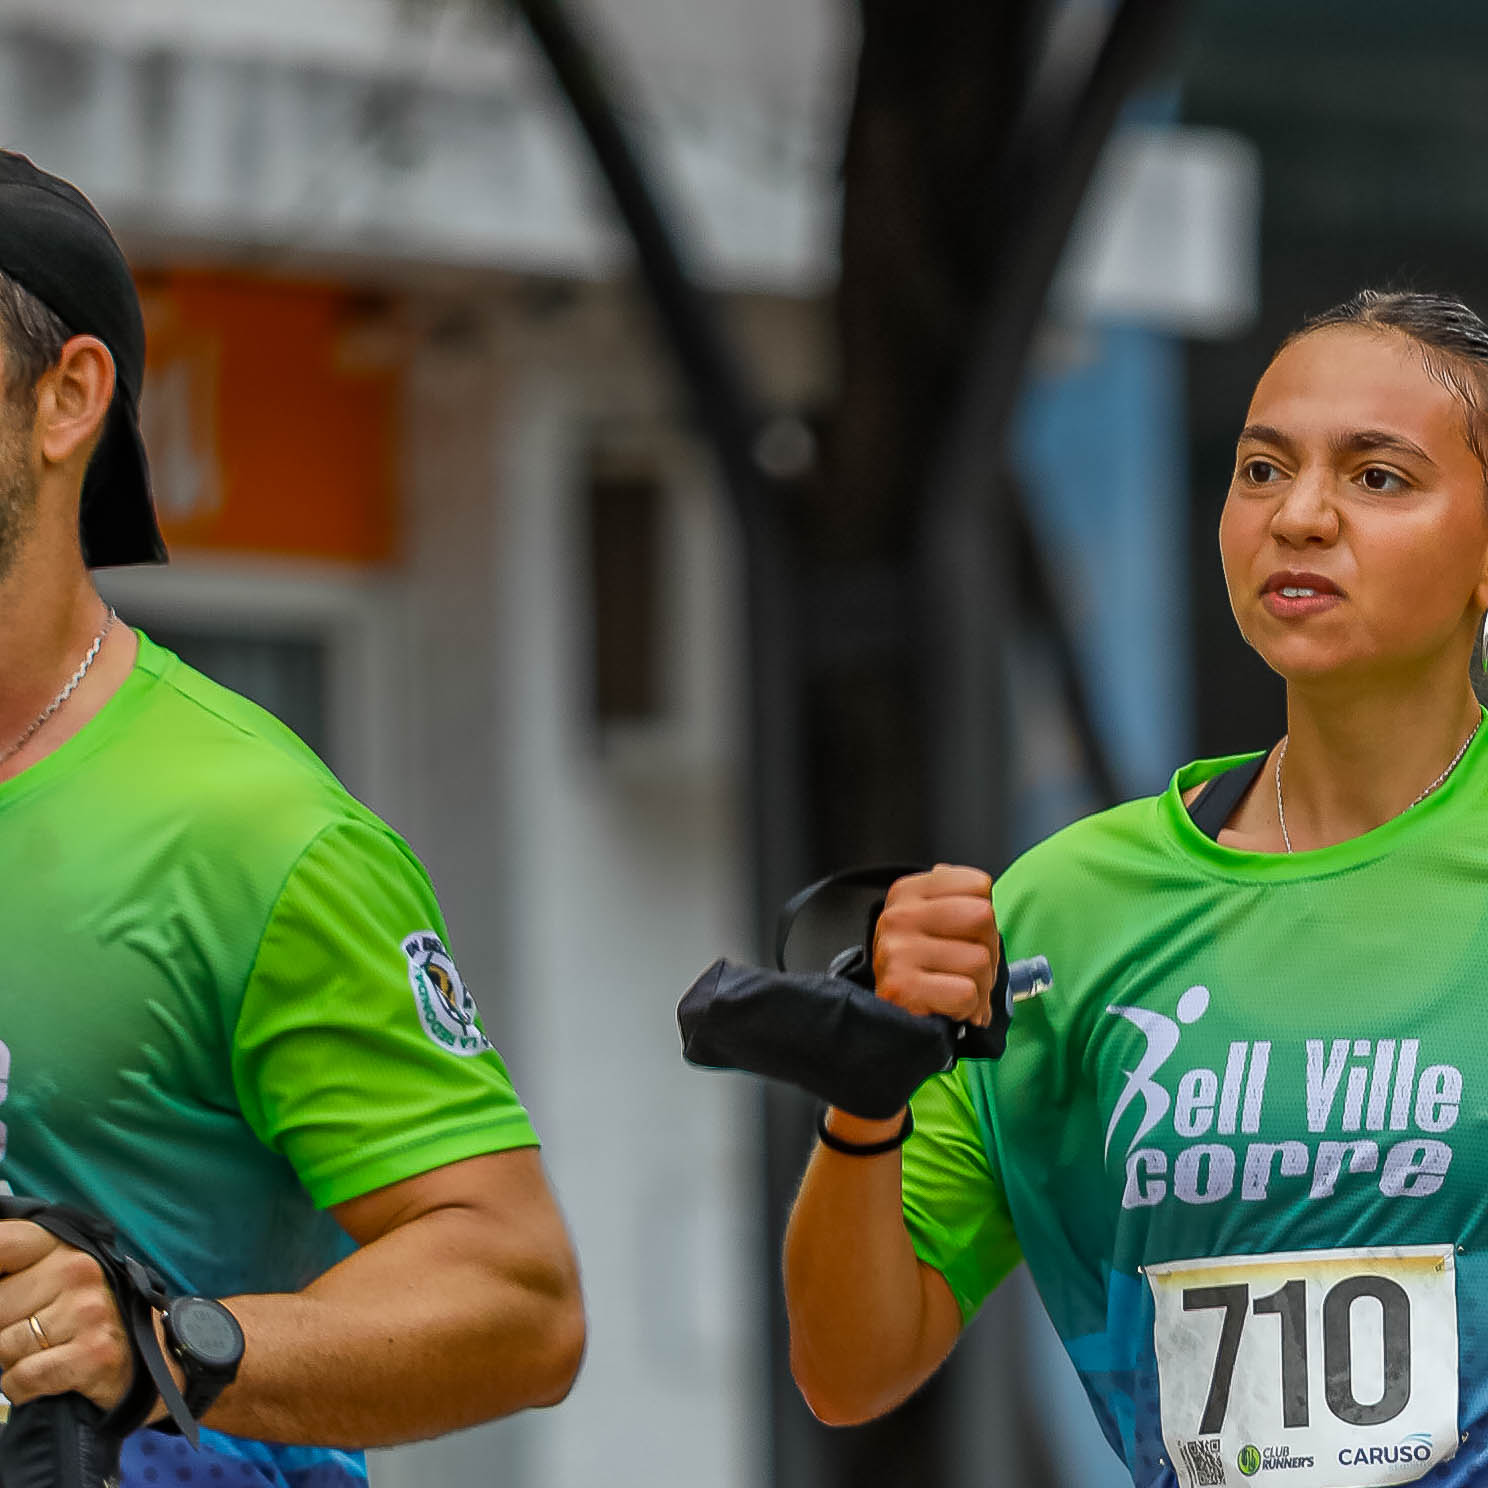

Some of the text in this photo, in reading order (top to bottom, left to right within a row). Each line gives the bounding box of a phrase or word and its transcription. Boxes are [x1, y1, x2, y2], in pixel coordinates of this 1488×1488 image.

[1305, 1038, 1464, 1133] Ville
[1182, 1274, 1412, 1436] 710
[1262, 1446, 1290, 1459] CLUB
[1338, 1444, 1431, 1466] CARUSO
